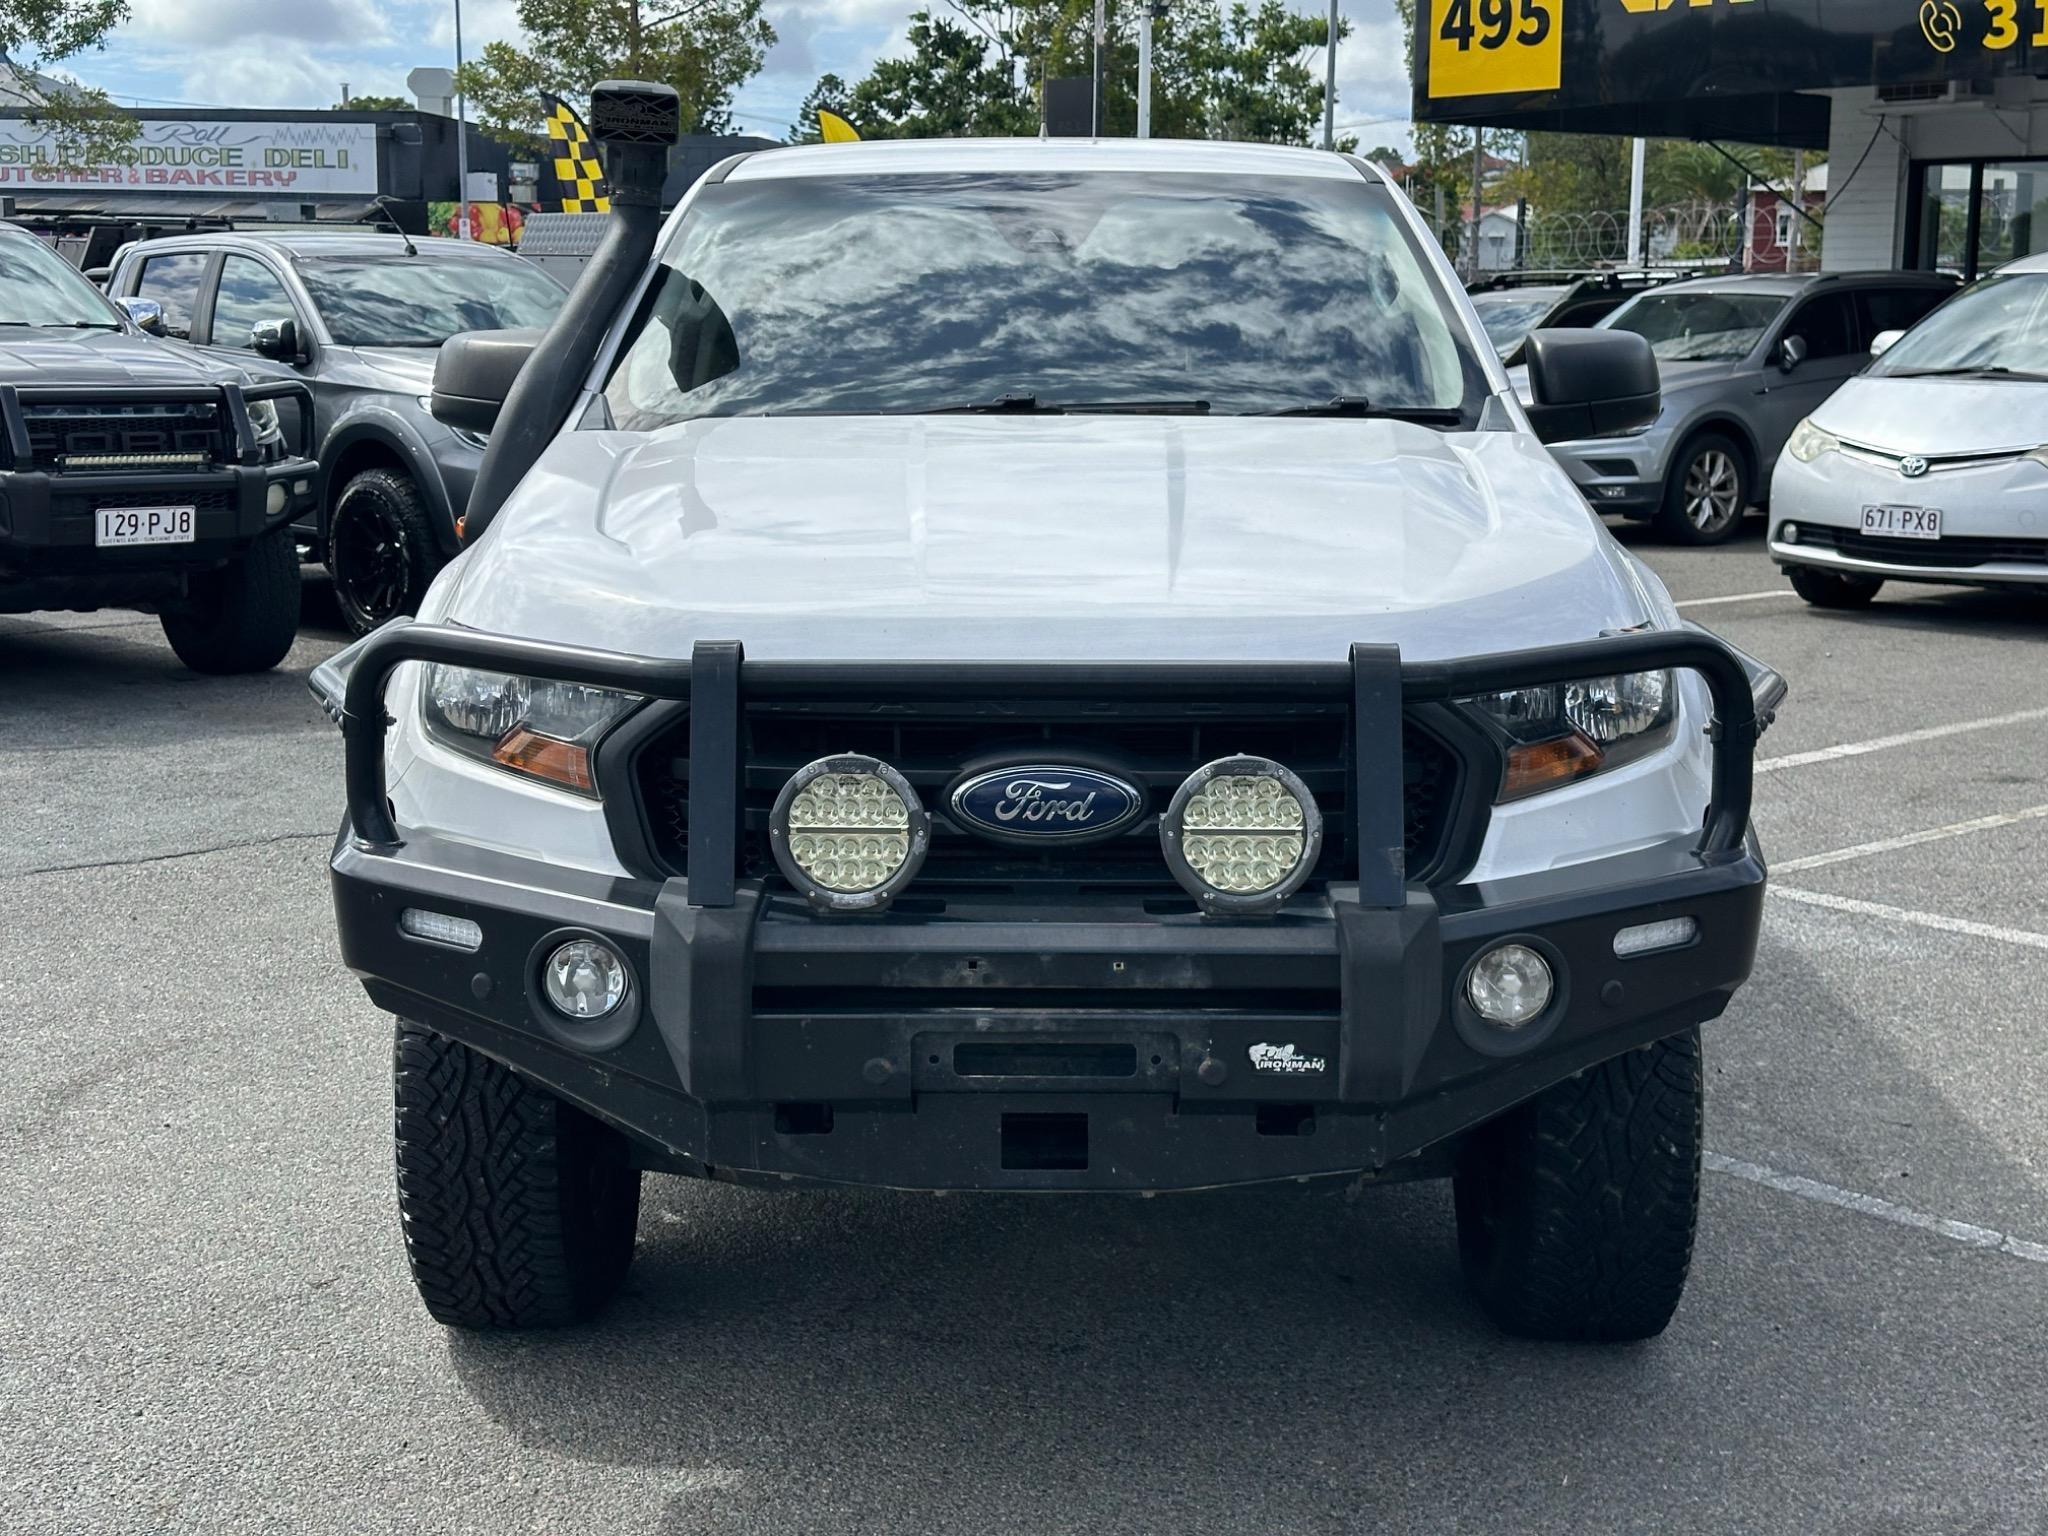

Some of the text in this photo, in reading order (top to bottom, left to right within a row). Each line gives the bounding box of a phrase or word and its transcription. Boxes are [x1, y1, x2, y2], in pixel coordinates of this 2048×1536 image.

[1440, 0, 1550, 51] 495
[148, 122, 240, 146] Roll
[60, 145, 243, 168] PODUCE
[127, 169, 140, 184] &
[145, 168, 297, 187] BAKERY
[993, 779, 1095, 822] Ford
[1260, 1060, 1321, 1069] IRONMAN
